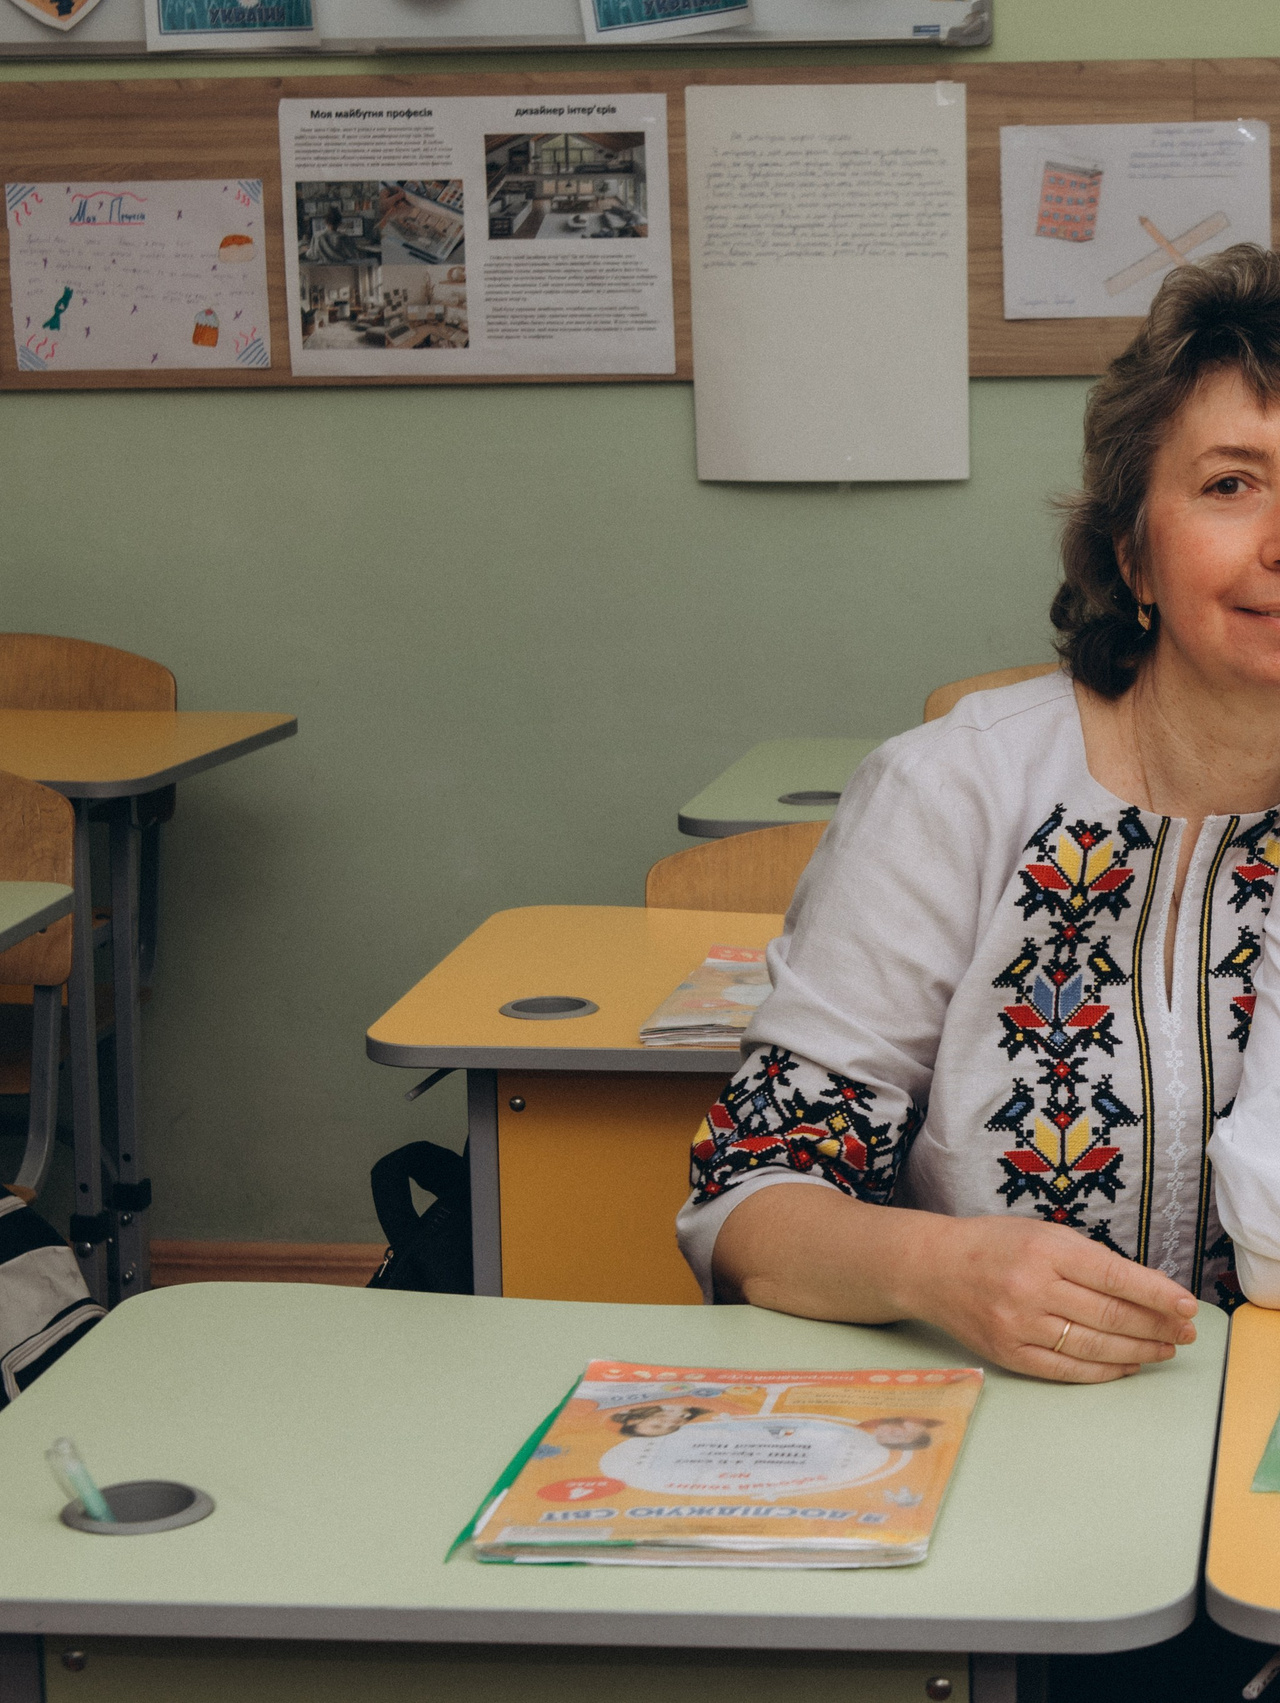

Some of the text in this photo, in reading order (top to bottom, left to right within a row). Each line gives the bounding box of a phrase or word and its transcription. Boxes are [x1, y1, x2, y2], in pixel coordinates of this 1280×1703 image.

[208, 5, 286, 25] УКРАЇНИ
[310, 107, 433, 120] Моя майбутня професія
[514, 105, 565, 118] дизайнер
[69, 198, 97, 223] Моя
[565, 1480, 609, 1488] клас
[568, 1486, 595, 1501] 4
[541, 1507, 616, 1523] СВІТ
[626, 1506, 857, 1522] ДОСЛІДЖУЮ
